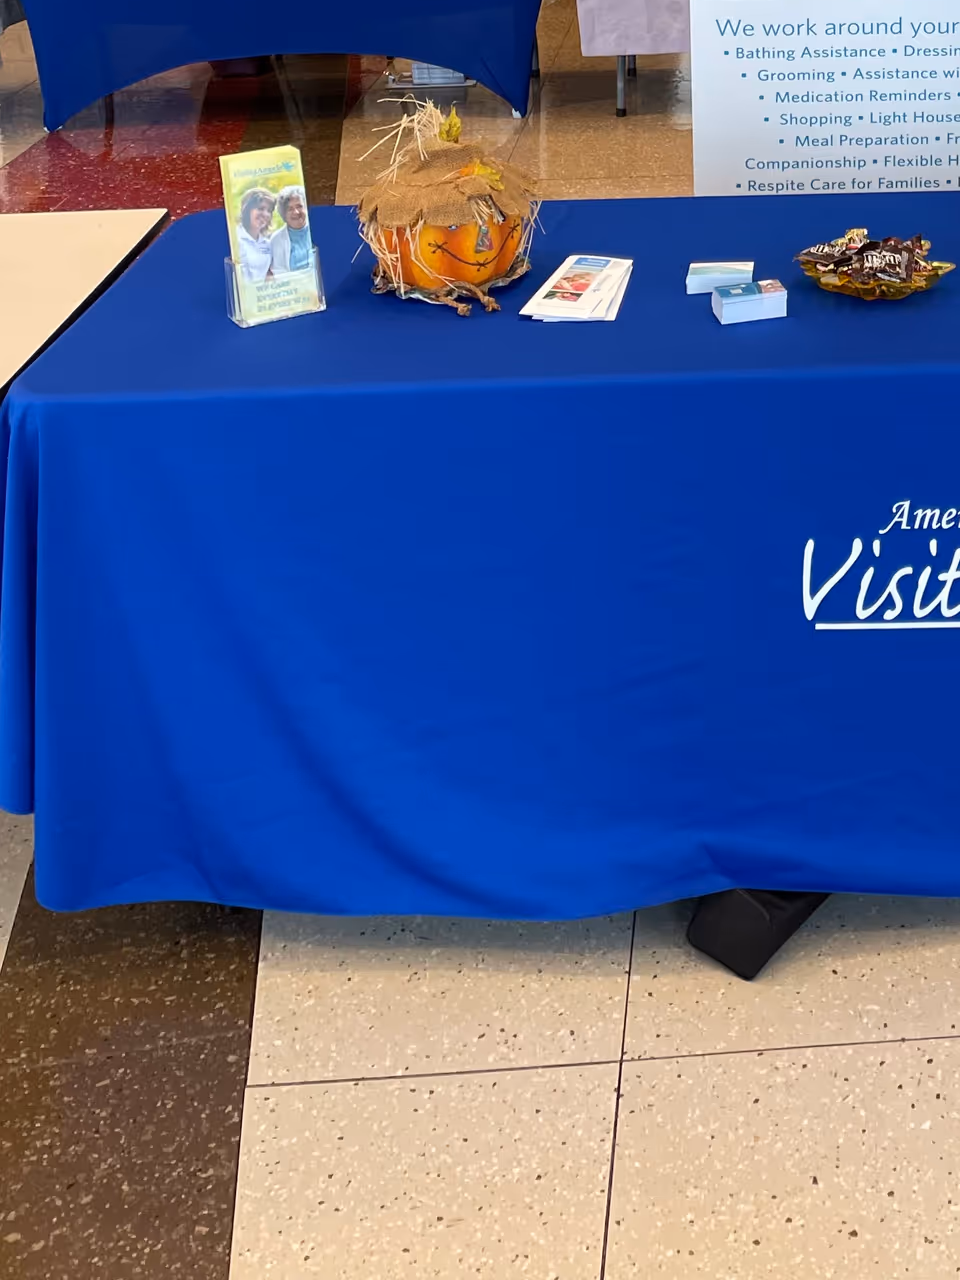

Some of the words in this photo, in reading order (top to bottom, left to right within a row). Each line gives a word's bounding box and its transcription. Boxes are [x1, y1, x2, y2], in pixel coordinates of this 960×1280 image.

[716, 18, 755, 37] We
[762, 18, 817, 37] work
[824, 17, 902, 36] around
[910, 20, 959, 39] your
[735, 46, 795, 62] Bathing
[801, 45, 886, 60] Assistance
[757, 69, 836, 84] Grooming
[853, 67, 938, 80] Assistance
[775, 90, 864, 104] Medication
[869, 89, 951, 103] Reminders
[779, 112, 852, 128] Shopping
[869, 111, 908, 127] Light
[794, 134, 834, 147] Meal
[839, 133, 929, 149] Preparation
[745, 156, 867, 171] Companionship
[883, 154, 943, 168] Flexible
[747, 178, 806, 195] Respite
[810, 178, 846, 191] Care
[850, 177, 873, 191] for
[877, 175, 941, 190] Families
